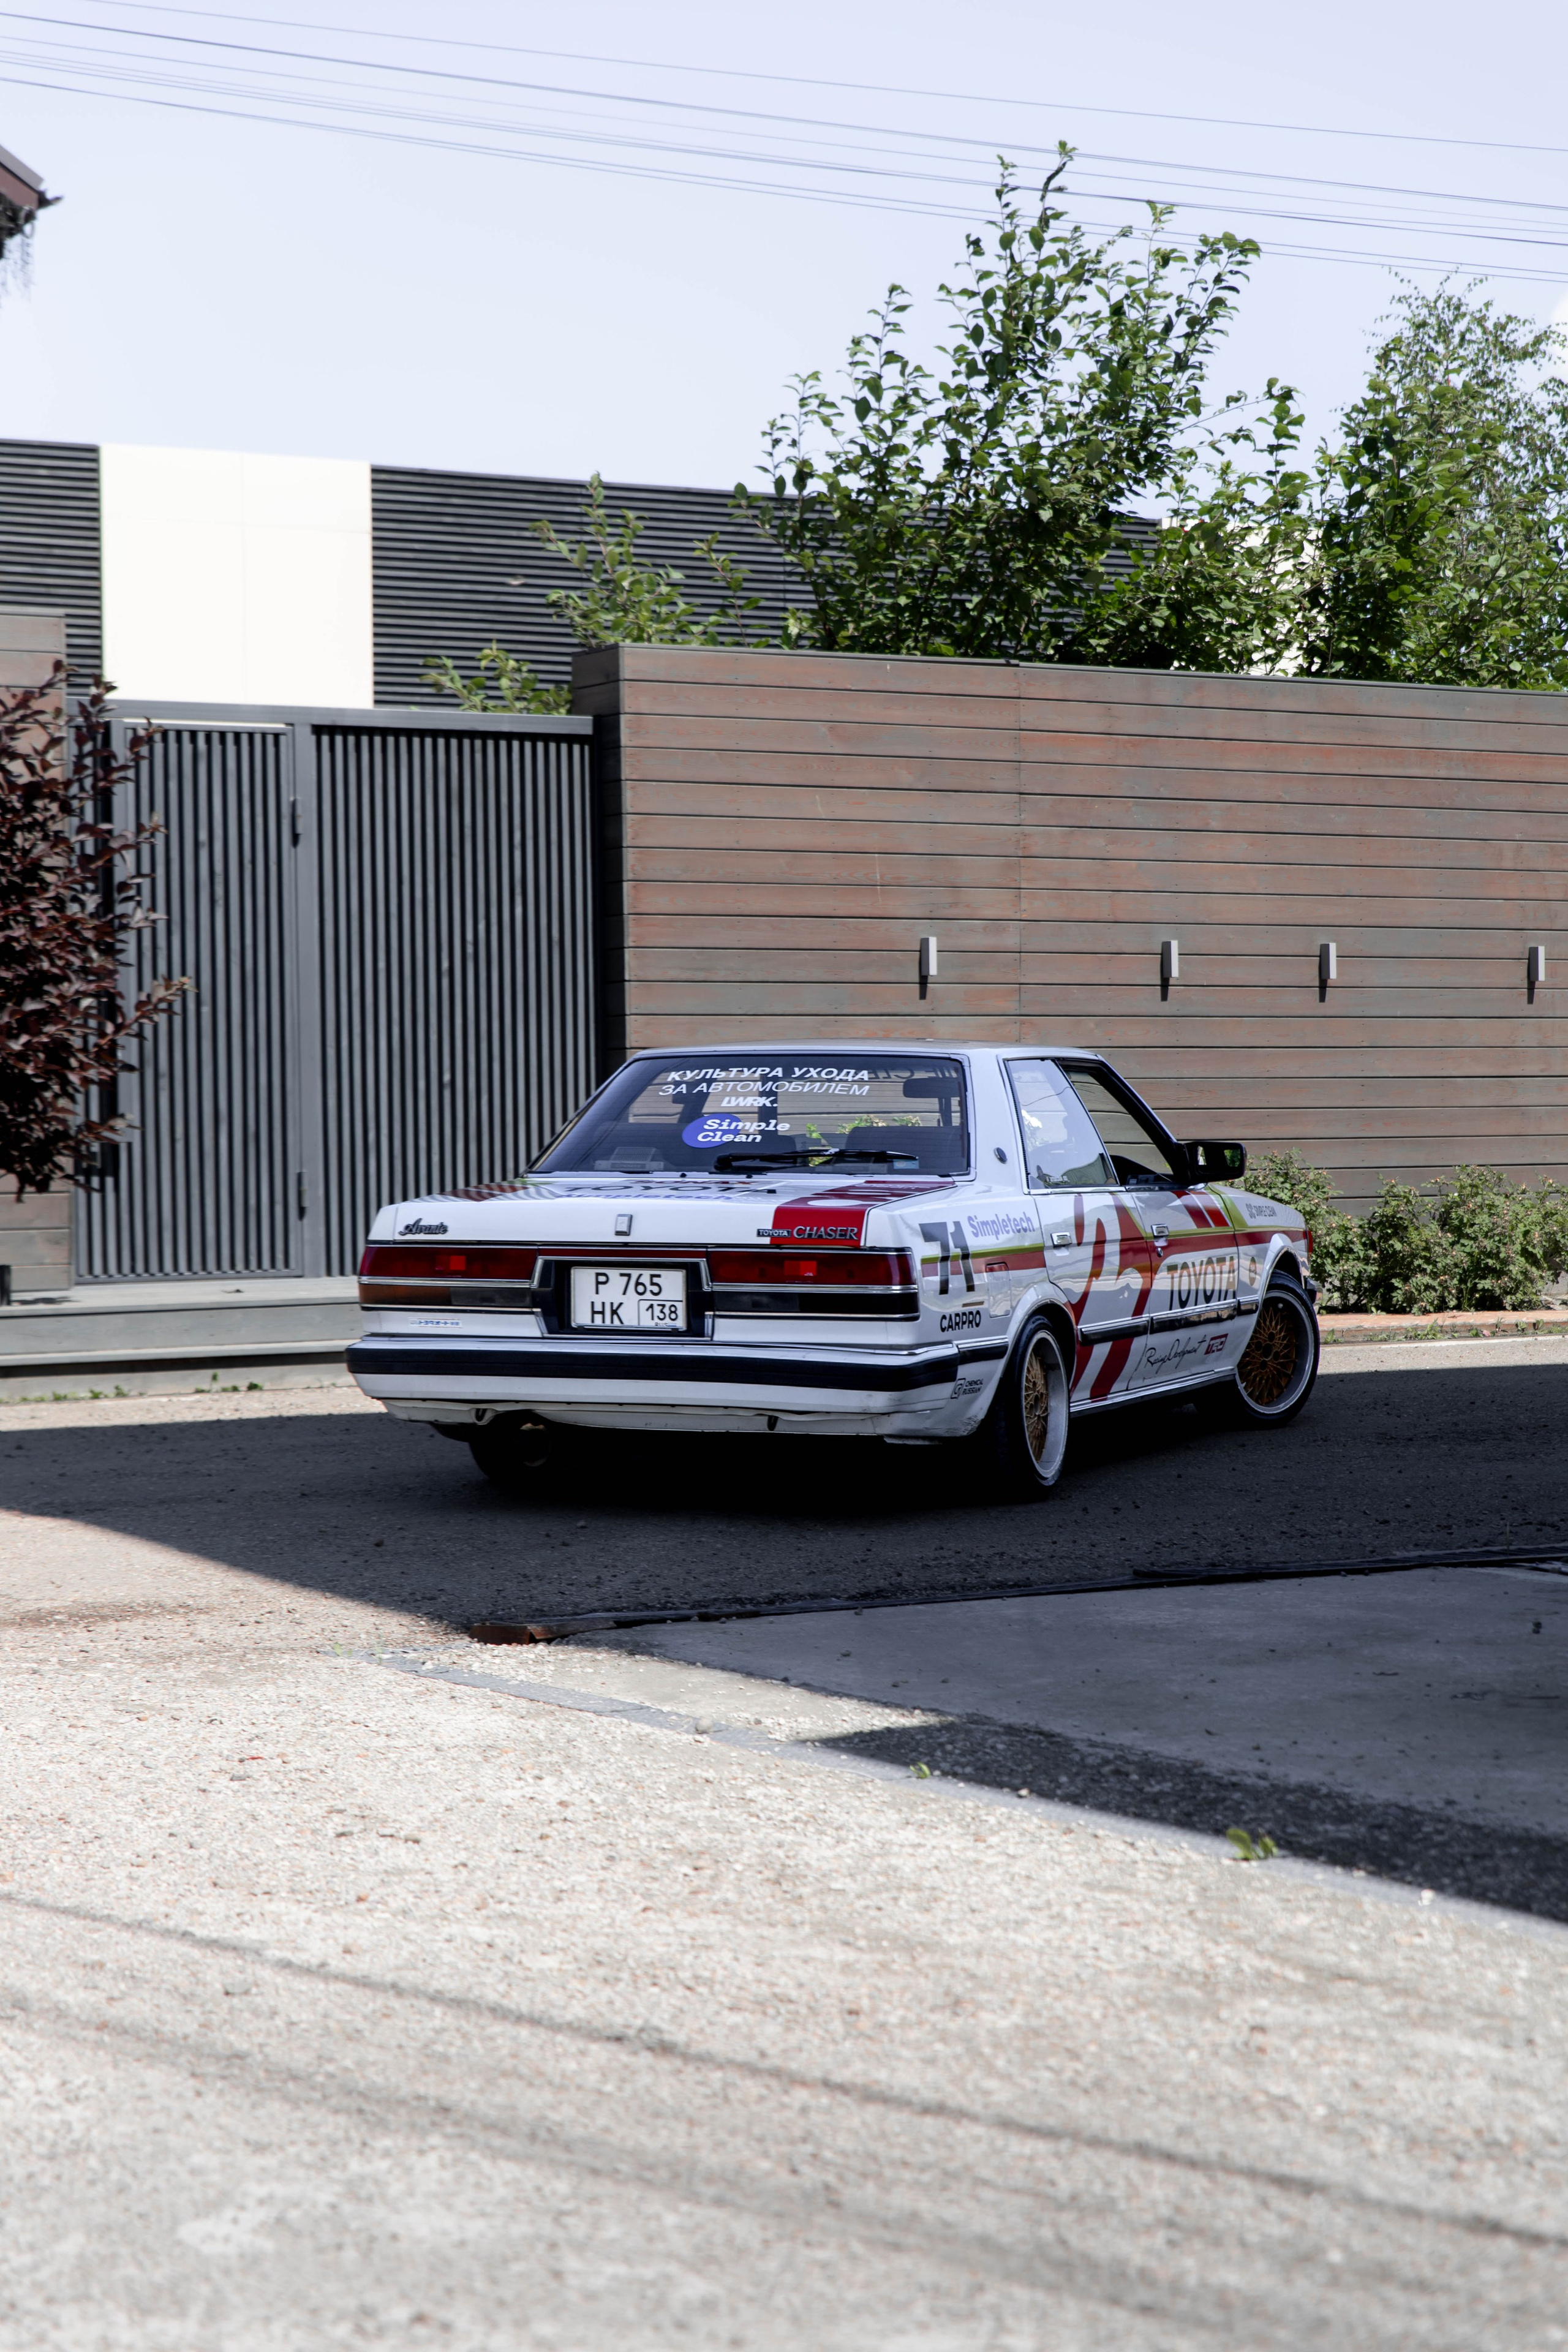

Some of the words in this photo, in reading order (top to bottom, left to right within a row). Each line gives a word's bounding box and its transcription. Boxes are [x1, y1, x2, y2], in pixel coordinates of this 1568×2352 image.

[667, 1067, 783, 1081] КУЛЬТУРА
[791, 1067, 870, 1082] УХОДА
[658, 1085, 688, 1096] ЗА
[692, 1081, 870, 1096] АВТОМОБИЛЕМ
[703, 1118, 790, 1132] Simple
[697, 1131, 763, 1142] Clean
[793, 1226, 858, 1240] CHASER
[967, 1212, 1035, 1240] Simpletech
[918, 1221, 975, 1295] 71
[619, 1273, 662, 1296] 765
[1166, 1256, 1236, 1311] TOYOTA
[646, 1303, 679, 1321] 138
[940, 1310, 981, 1333] CARPRO
